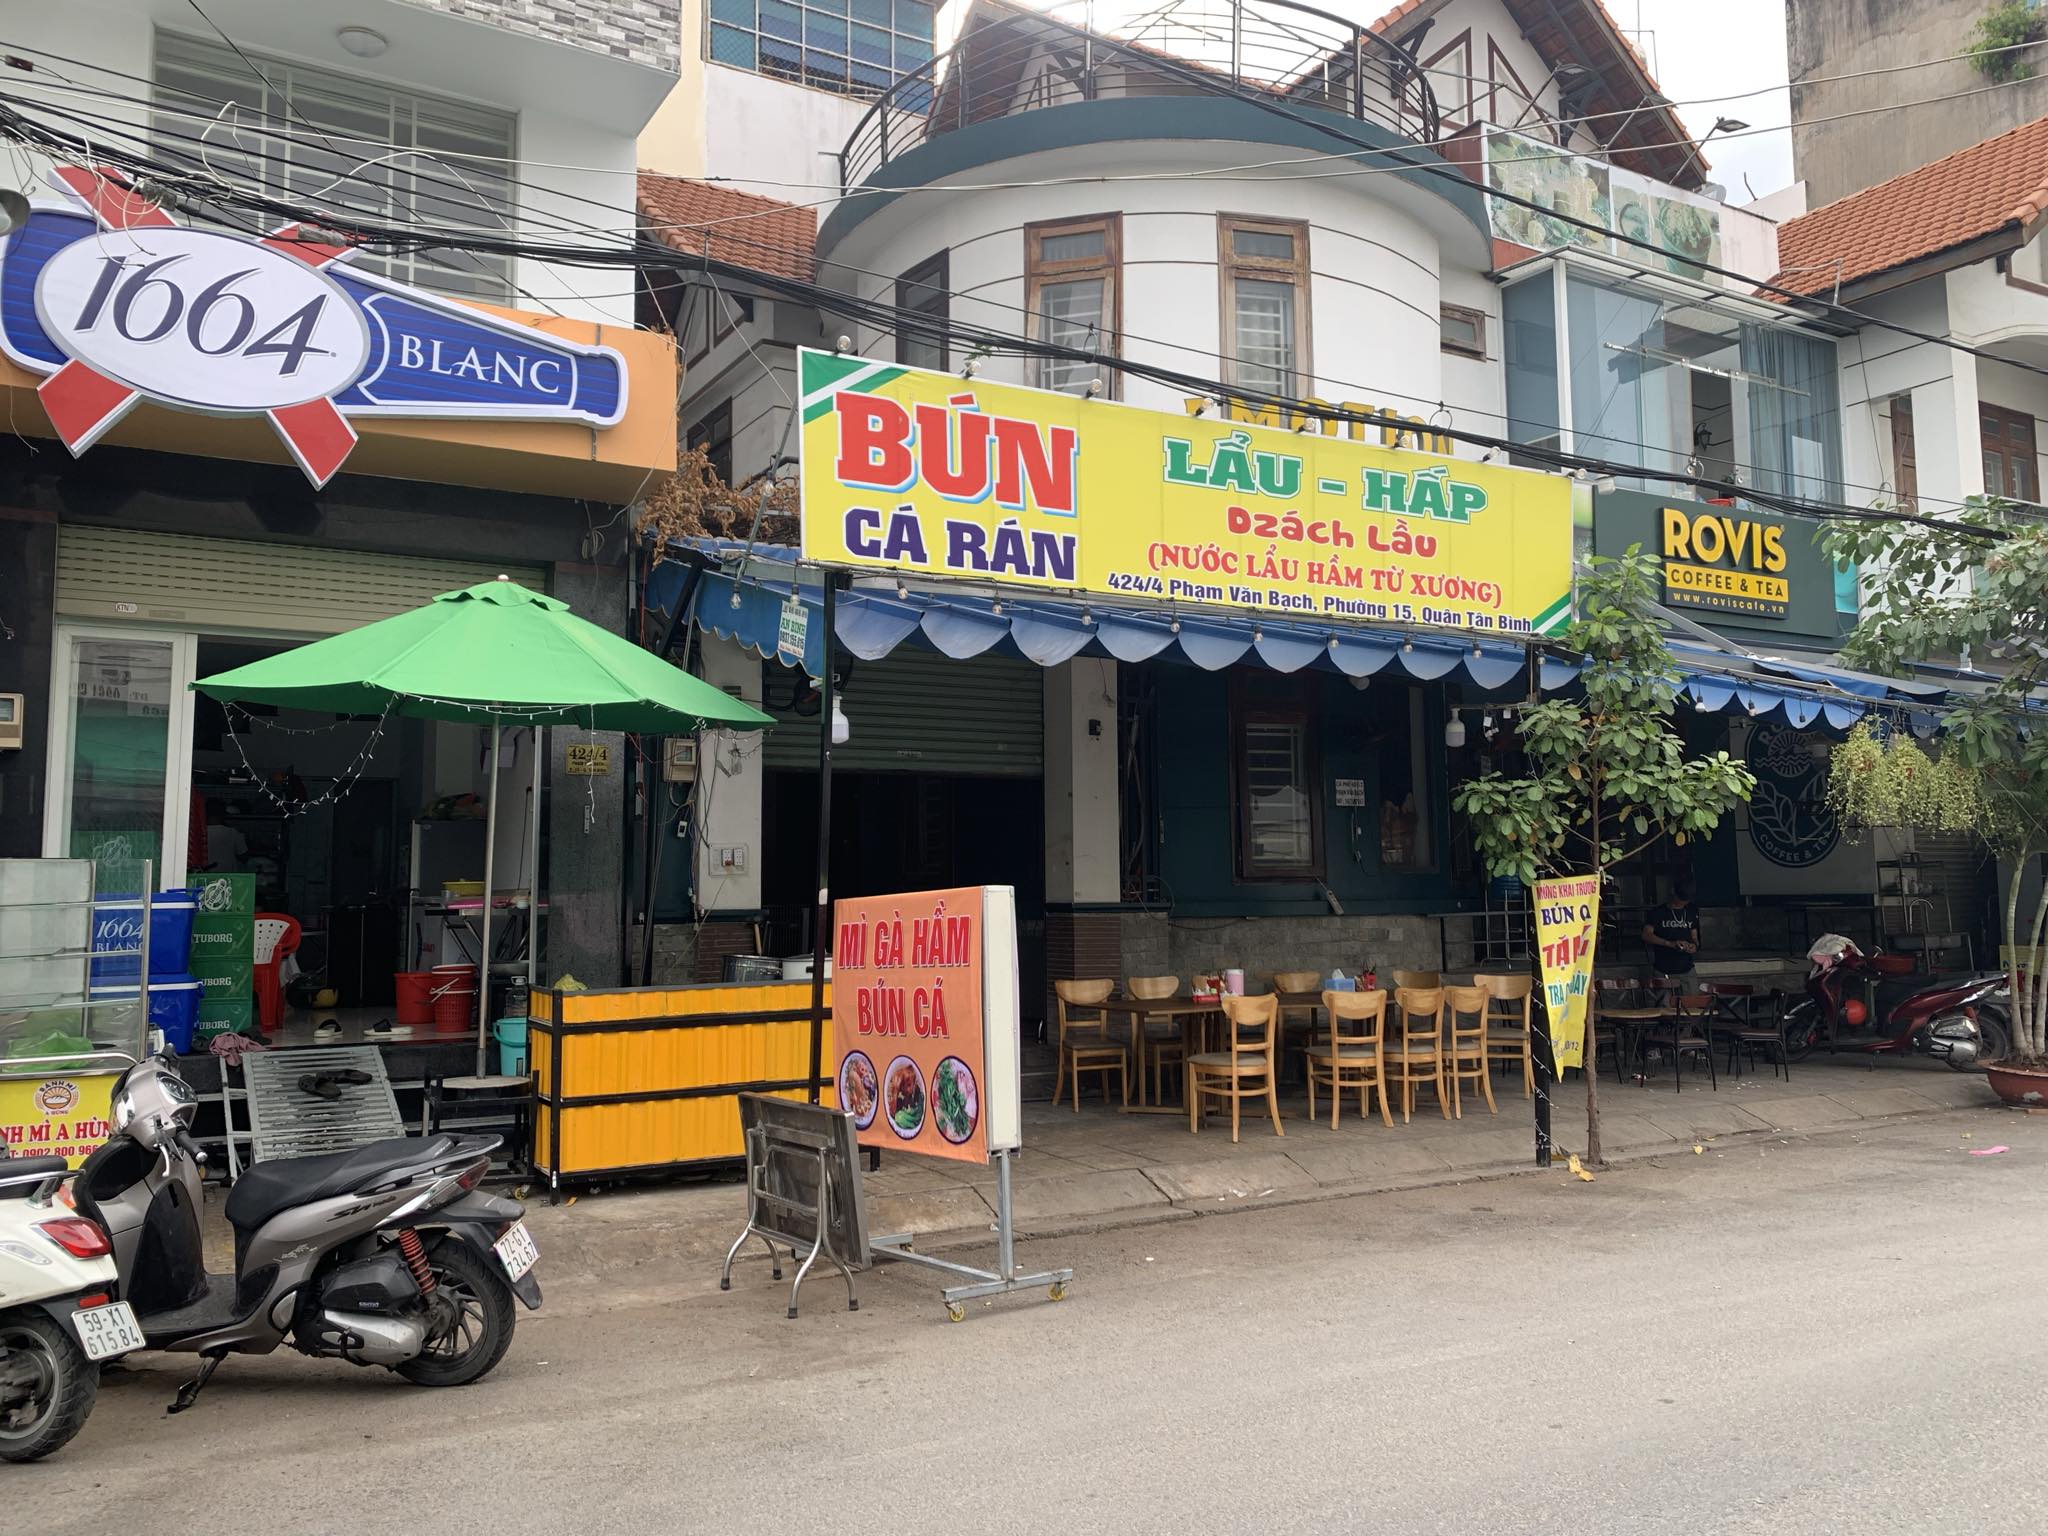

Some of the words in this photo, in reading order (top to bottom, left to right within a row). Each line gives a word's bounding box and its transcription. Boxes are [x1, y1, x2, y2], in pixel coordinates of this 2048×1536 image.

[74, 253, 332, 377] 1664
[400, 333, 562, 396] BLANC
[834, 391, 1080, 518] BÚN
[1162, 430, 1304, 500] LẨU
[1361, 465, 1489, 526] HẤP
[844, 505, 928, 565] CÁ
[944, 518, 1078, 582] RÁN
[1227, 506, 1355, 549] Dzách
[1367, 518, 1437, 559] Lầu
[1662, 507, 1788, 574] ROVIS
[1147, 542, 1239, 575] (NƯỚC
[1245, 543, 1299, 582] LẨU
[1306, 553, 1364, 589] HẦM
[1370, 565, 1405, 594] TỪ
[1409, 573, 1502, 610] XƯƠNG)
[1670, 567, 1734, 591] COFFEE
[1738, 576, 1750, 594] &
[1756, 579, 1785, 598] TEA
[1107, 572, 1163, 594] 424/4
[1169, 578, 1223, 602] Phạm
[1229, 585, 1263, 604] Văn
[1268, 589, 1319, 612] Bạch,
[1323, 596, 1387, 619] Phường
[1391, 603, 1417, 623] 15,
[1465, 610, 1494, 628] Tân
[1497, 614, 1532, 632] Bình
[569, 747, 608, 761] 424/4
[1759, 832, 1801, 862] COFFEE
[838, 911, 869, 969] MÌ
[873, 910, 905, 969] GÀ
[911, 899, 973, 968] HẦM
[1541, 901, 1575, 926] BÚN
[193, 933, 233, 944] TUBORG
[201, 977, 232, 987] UBORG
[857, 977, 907, 1037] BÚN
[912, 976, 951, 1040] CÁ
[28, 1119, 52, 1143] MÌ
[55, 1123, 70, 1141] A
[74, 1116, 110, 1140] HÙN
[54, 1145, 76, 1157] 800
[507, 1241, 536, 1278] 734.67
[83, 1306, 126, 1333] 59-X1
[86, 1325, 140, 1356] 615.84
